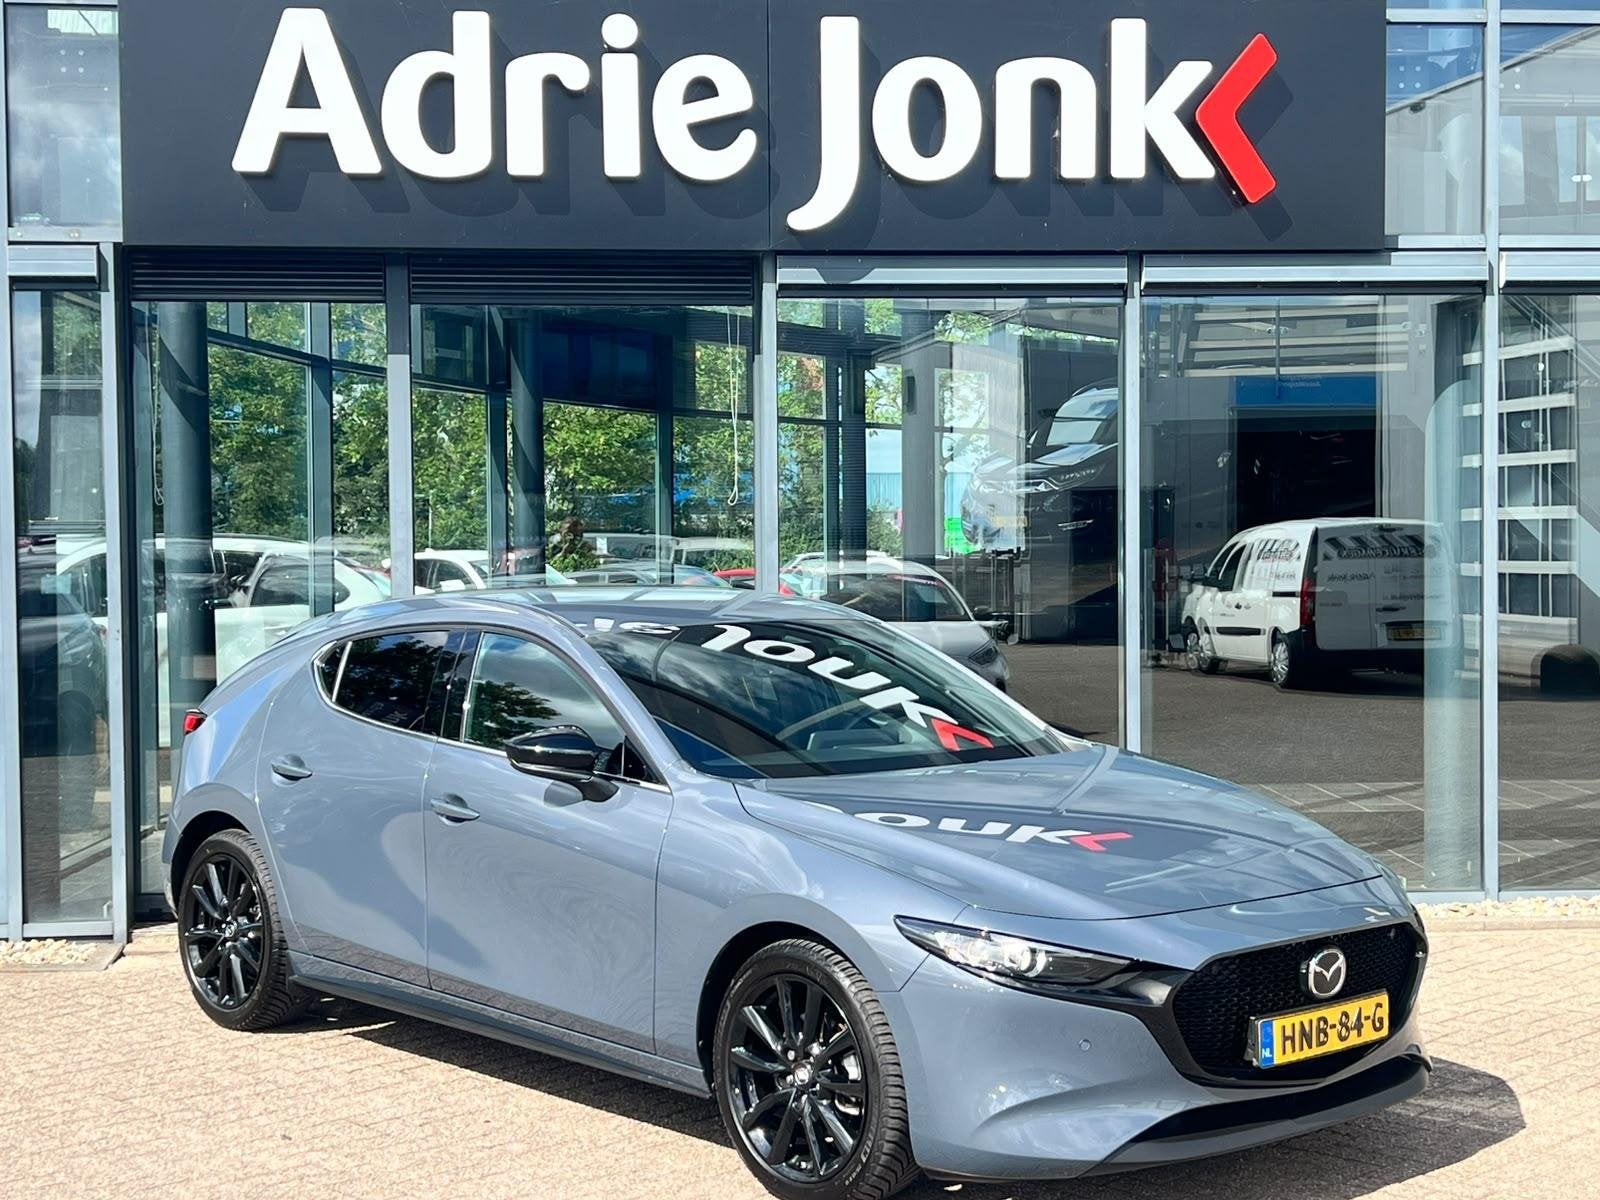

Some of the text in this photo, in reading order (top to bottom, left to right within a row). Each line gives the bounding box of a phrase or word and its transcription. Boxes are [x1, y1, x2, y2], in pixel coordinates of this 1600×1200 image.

[231, 7, 1217, 231] Adrie Jonk
[1261, 1047, 1273, 1059] NL
[1281, 1003, 1384, 1055] HNB-84-G
